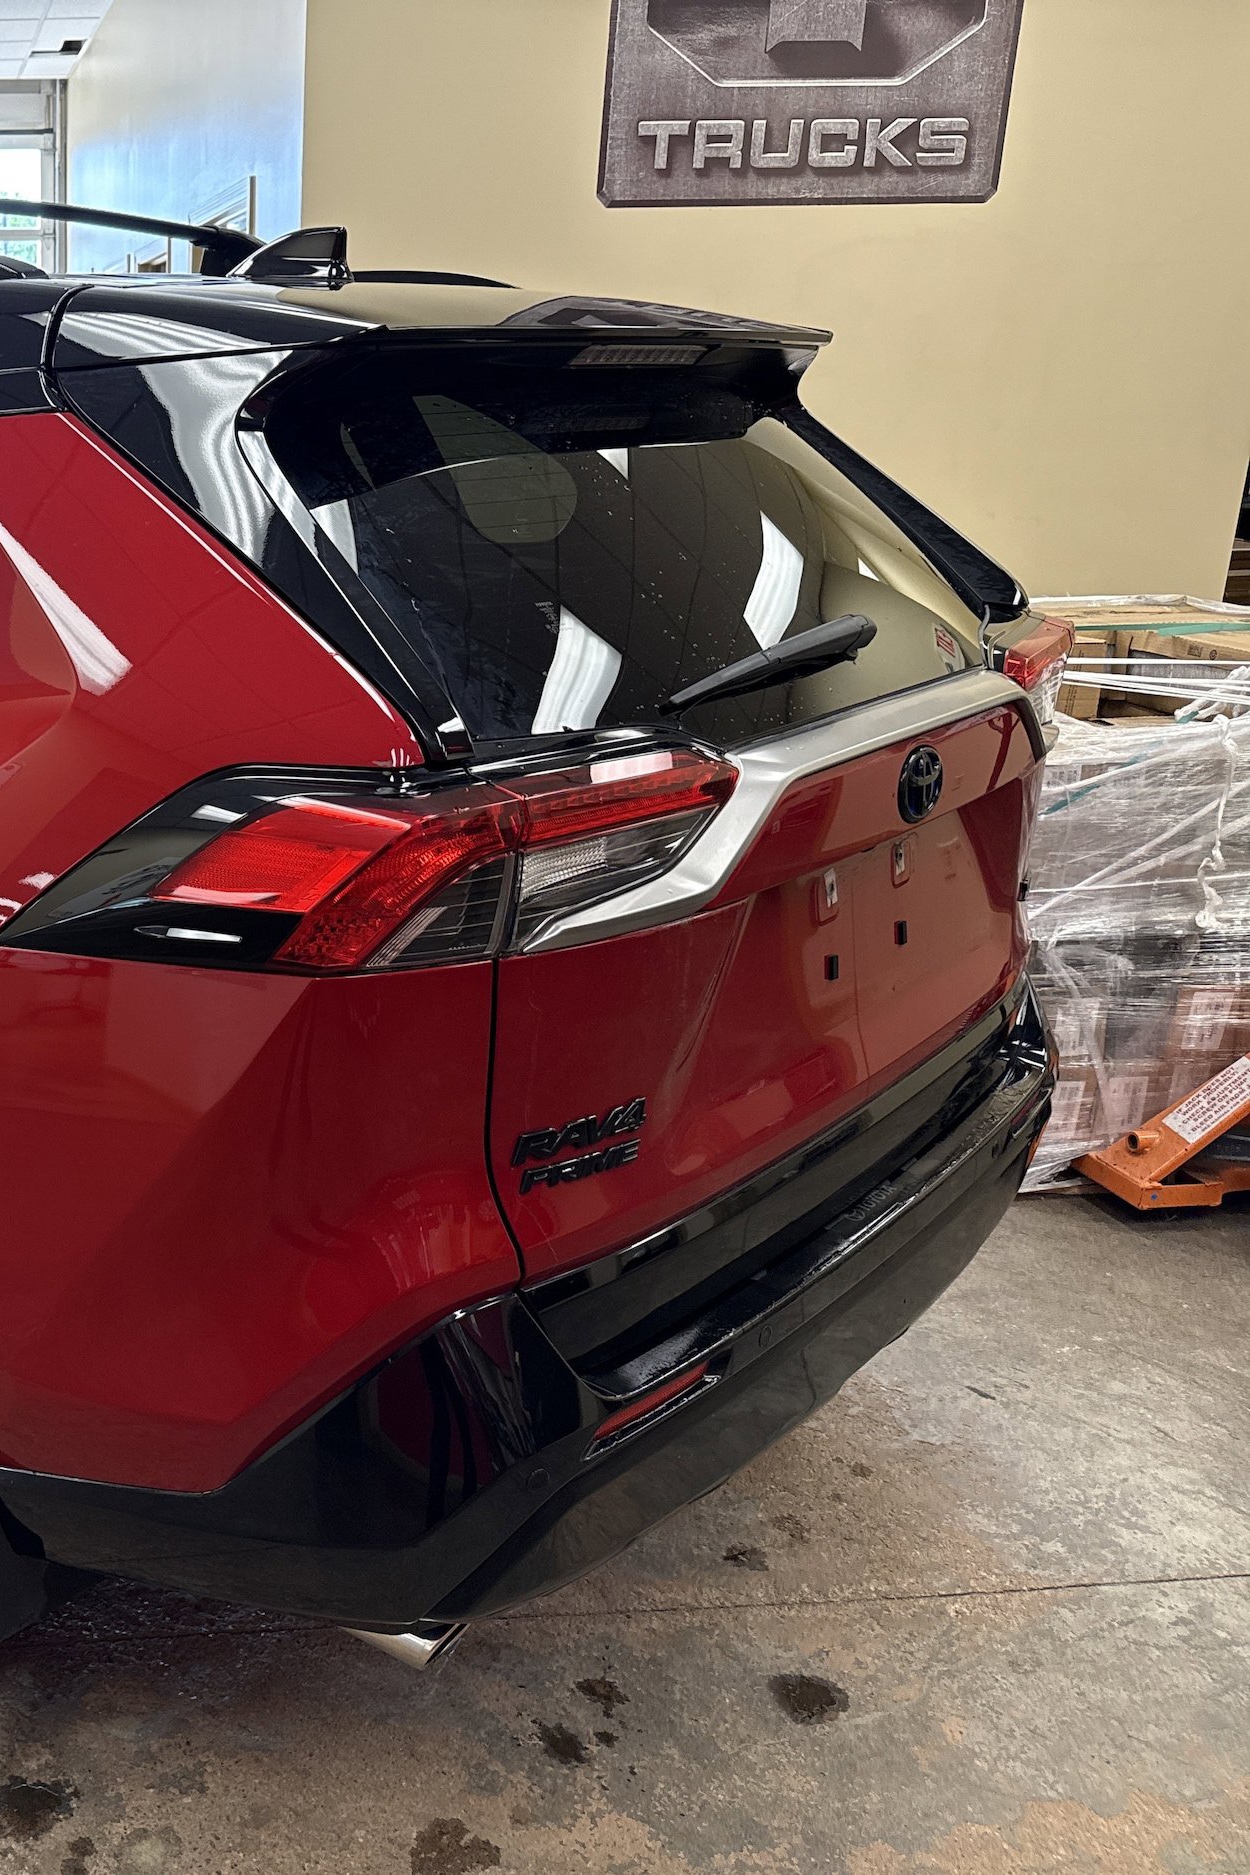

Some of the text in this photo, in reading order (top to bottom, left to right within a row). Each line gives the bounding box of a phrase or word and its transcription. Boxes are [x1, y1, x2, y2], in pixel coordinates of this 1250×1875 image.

[637, 117, 970, 170] TRUCKS
[1181, 1099, 1203, 1117] WORK
[1184, 1093, 1203, 1108] JACK
[1202, 1078, 1221, 1094] DOES
[1220, 1066, 1235, 1079] NOT
[1192, 1102, 1217, 1122] SCREW
[1217, 1093, 1229, 1103] ON
[1228, 1077, 1248, 1094] PUMP
[512, 1097, 646, 1167] RAV4
[1182, 1105, 1206, 1125] CHECK
[1191, 1088, 1245, 1132] BLEED AIR FROM
[519, 1138, 641, 1194] PRIME
